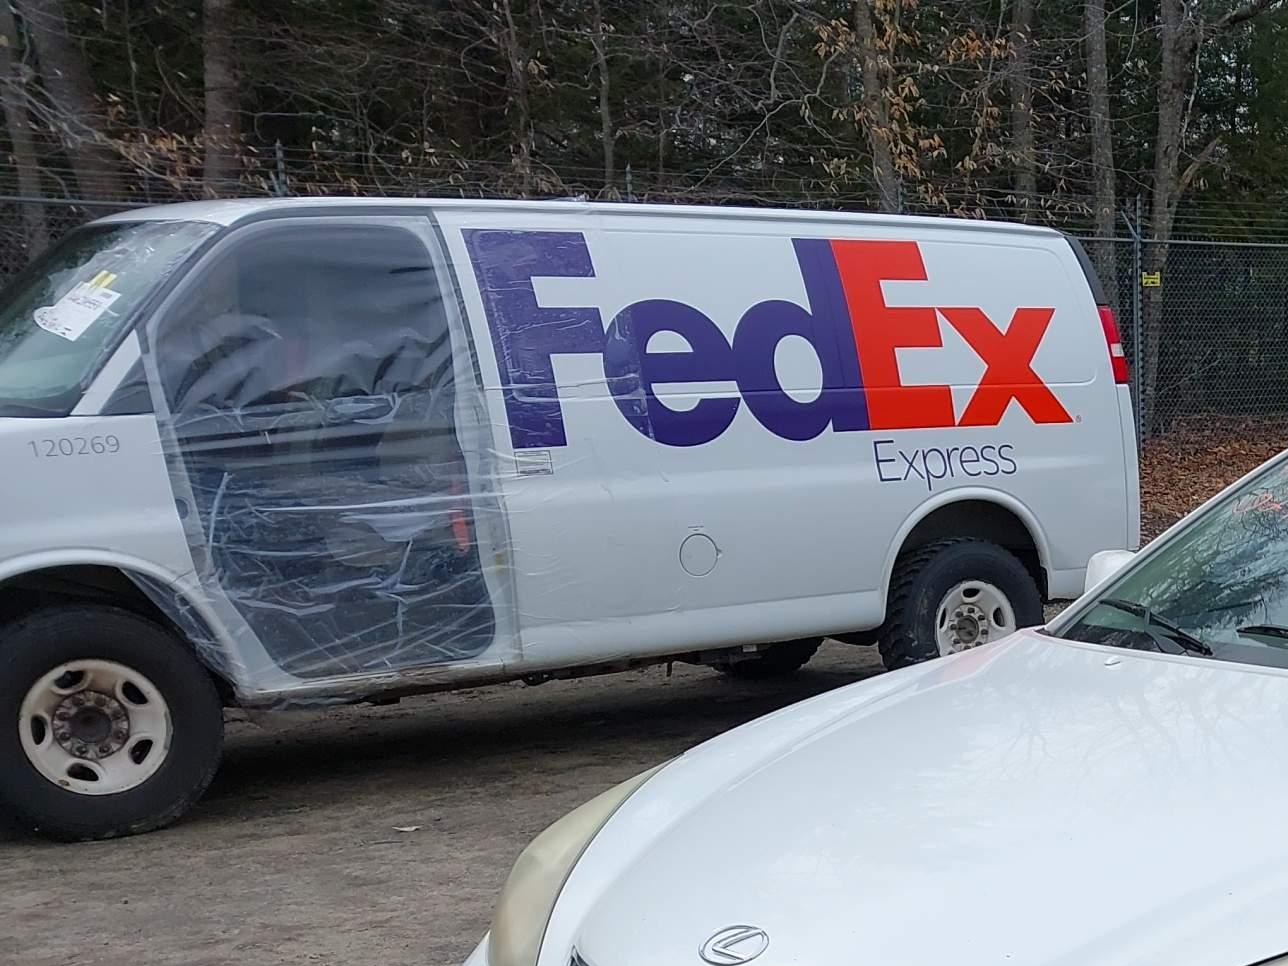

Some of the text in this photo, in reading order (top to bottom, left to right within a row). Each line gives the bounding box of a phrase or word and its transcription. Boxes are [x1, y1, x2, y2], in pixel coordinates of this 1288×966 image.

[462, 229, 1074, 447] FedEx
[29, 435, 120, 457] 120269
[873, 439, 1018, 491] Express
